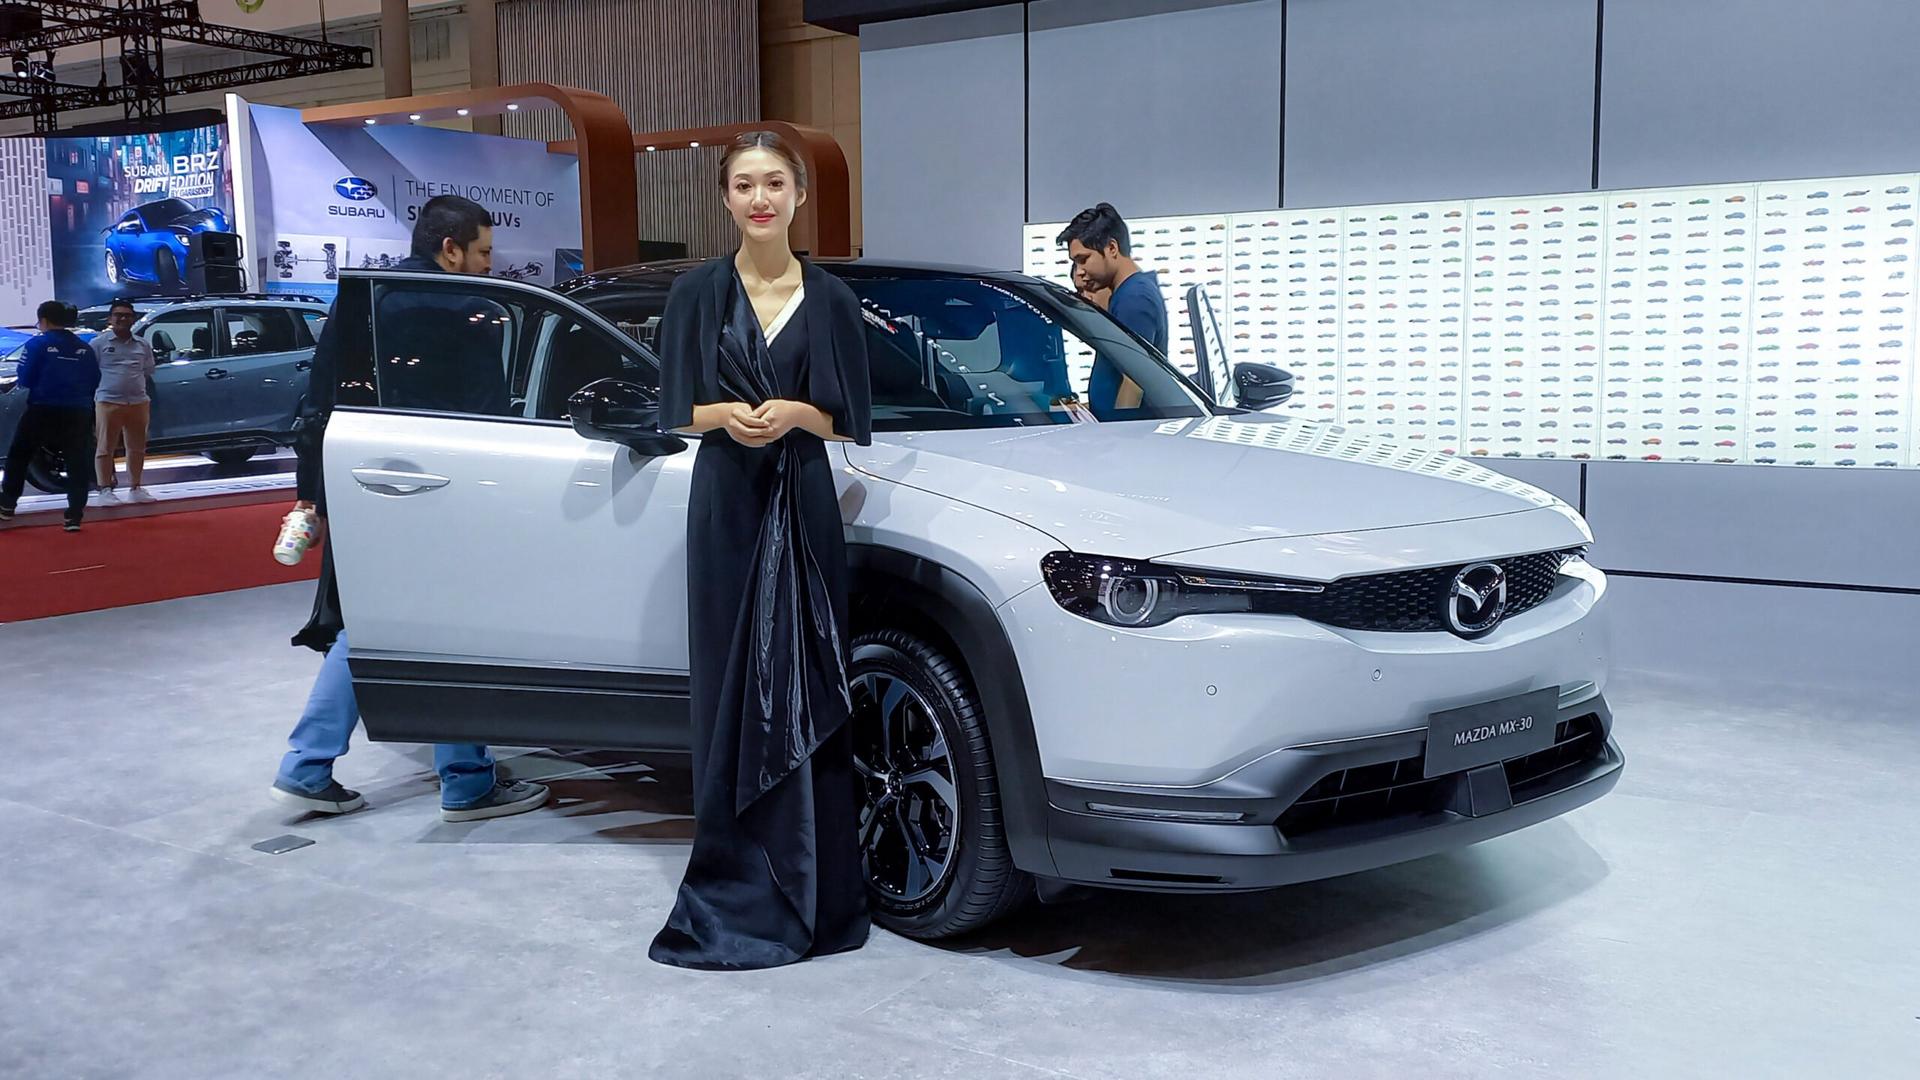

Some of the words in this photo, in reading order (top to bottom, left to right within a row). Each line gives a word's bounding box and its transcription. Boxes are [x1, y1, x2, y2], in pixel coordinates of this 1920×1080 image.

[124, 164, 170, 177] SUBARU
[173, 151, 219, 174] BRZ
[134, 177, 169, 193] DRIFT
[169, 172, 214, 187] EDITION
[405, 180, 435, 197] THE
[440, 183, 532, 205] ENJOYMENT
[535, 191, 554, 207] OF
[328, 205, 385, 218] SUBARU
[492, 211, 521, 228] UVs
[1454, 725, 1496, 746] MAZDA
[1499, 716, 1533, 736] MX-30
